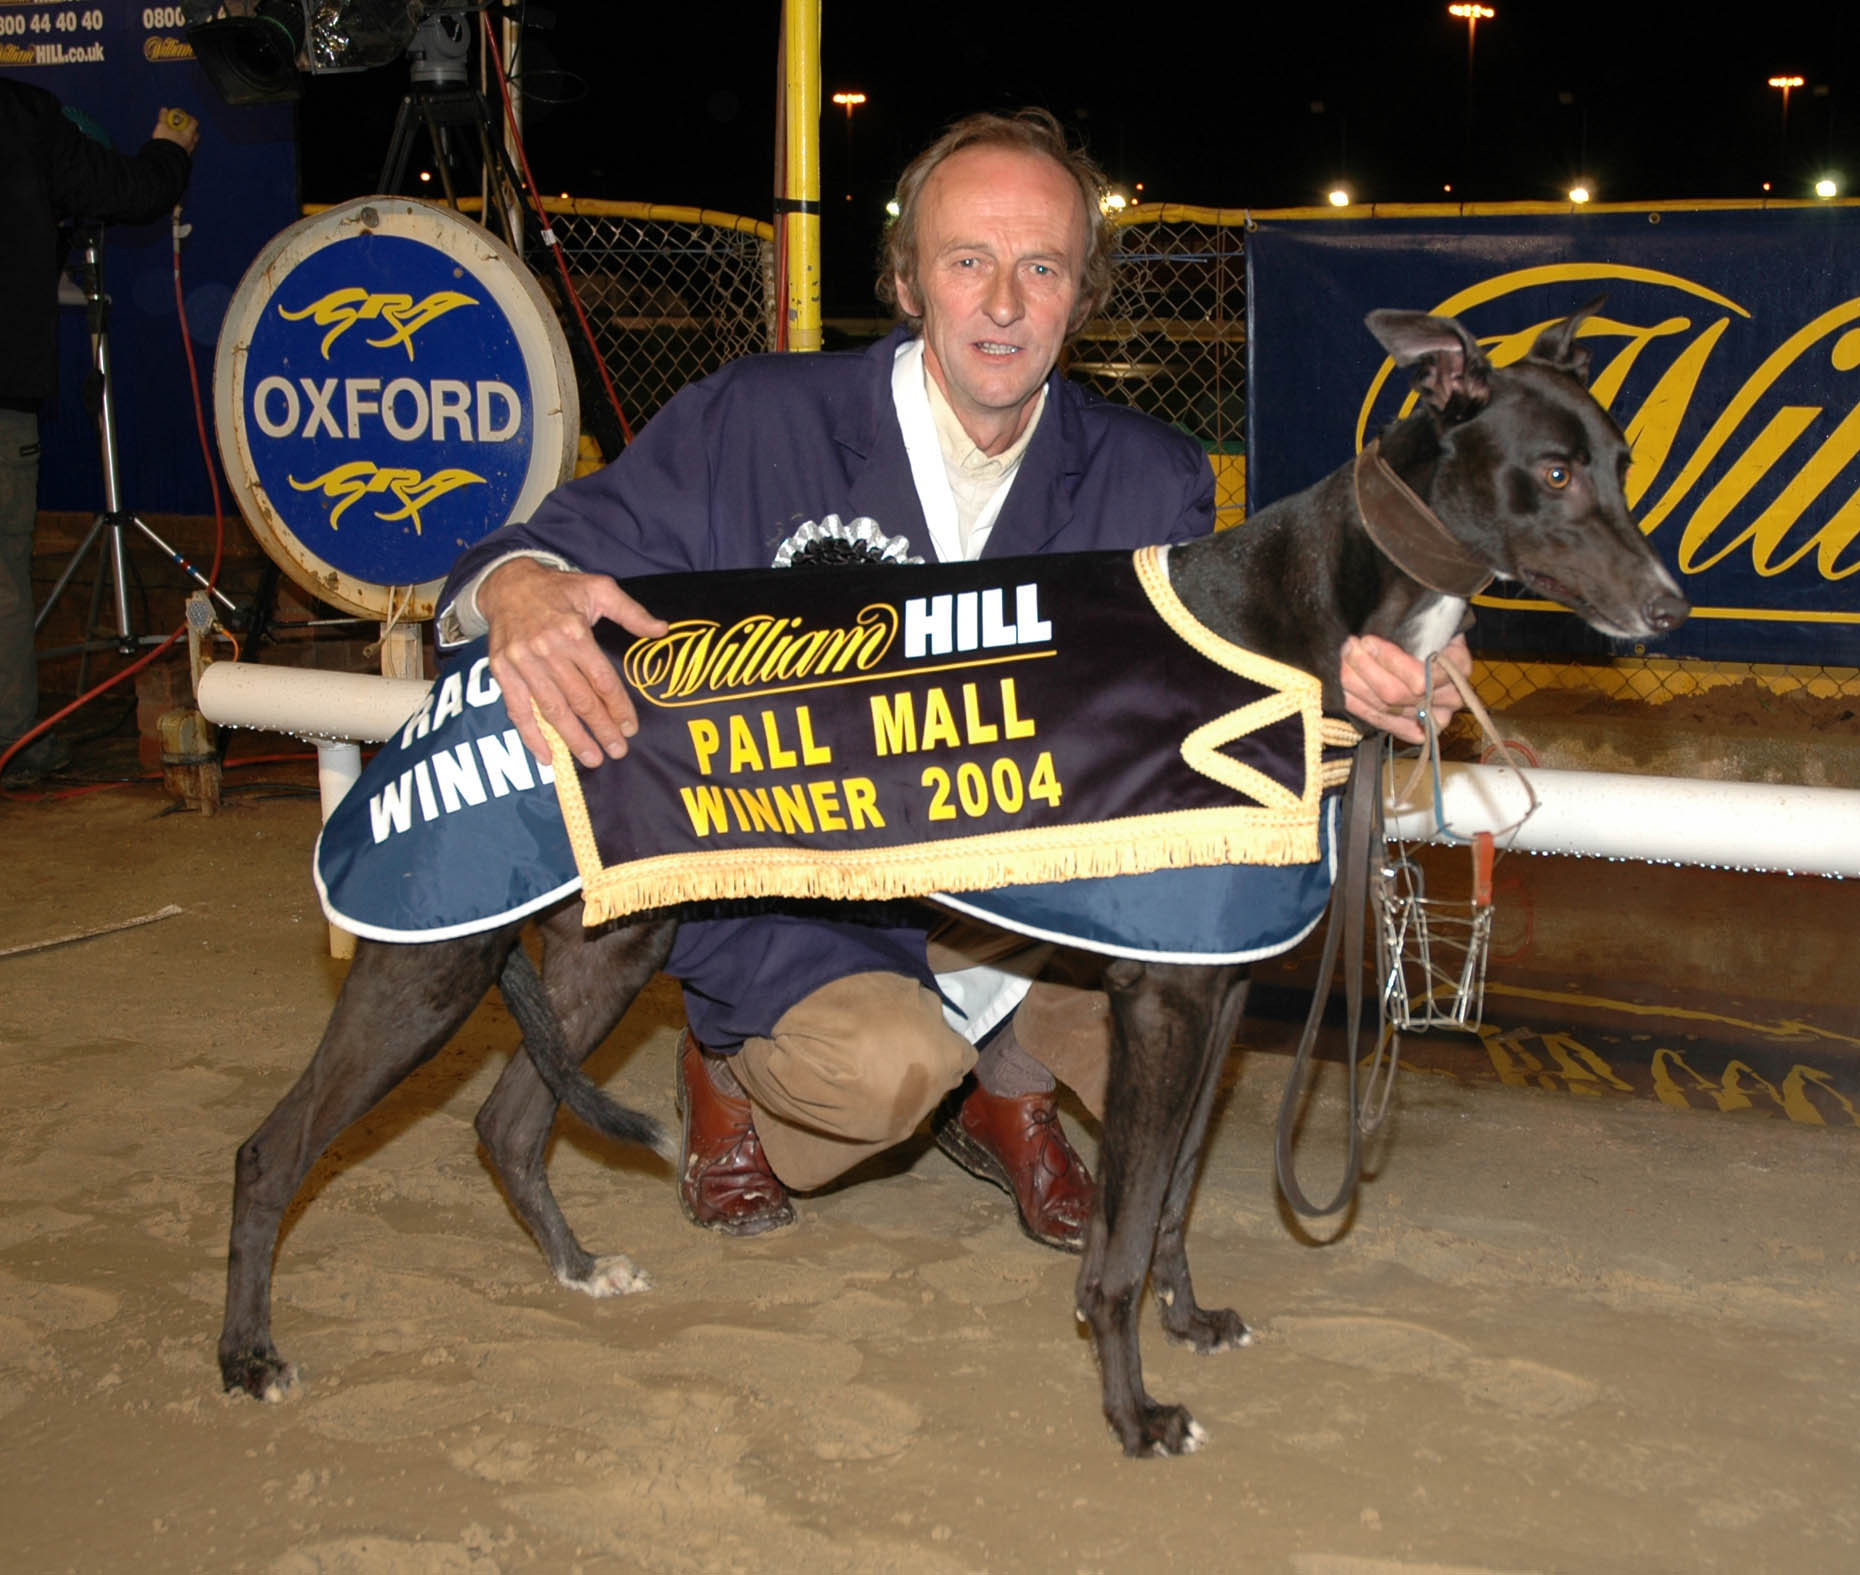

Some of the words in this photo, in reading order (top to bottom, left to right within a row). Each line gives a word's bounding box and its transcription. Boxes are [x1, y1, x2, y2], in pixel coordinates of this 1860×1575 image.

[0, 43, 35, 63] illiam
[30, 14, 51, 33] 44
[56, 12, 77, 31] 40
[82, 10, 103, 30] 40
[143, 7, 186, 29] 0800
[253, 376, 522, 442] OXFORD
[623, 603, 899, 702] William
[904, 583, 1053, 658] HILL
[400, 657, 502, 750] RAC
[687, 706, 832, 776] PALL
[869, 677, 1036, 757] MALL
[369, 729, 555, 845] WINN
[680, 776, 886, 838] WINNER
[921, 751, 1063, 822] 2004
